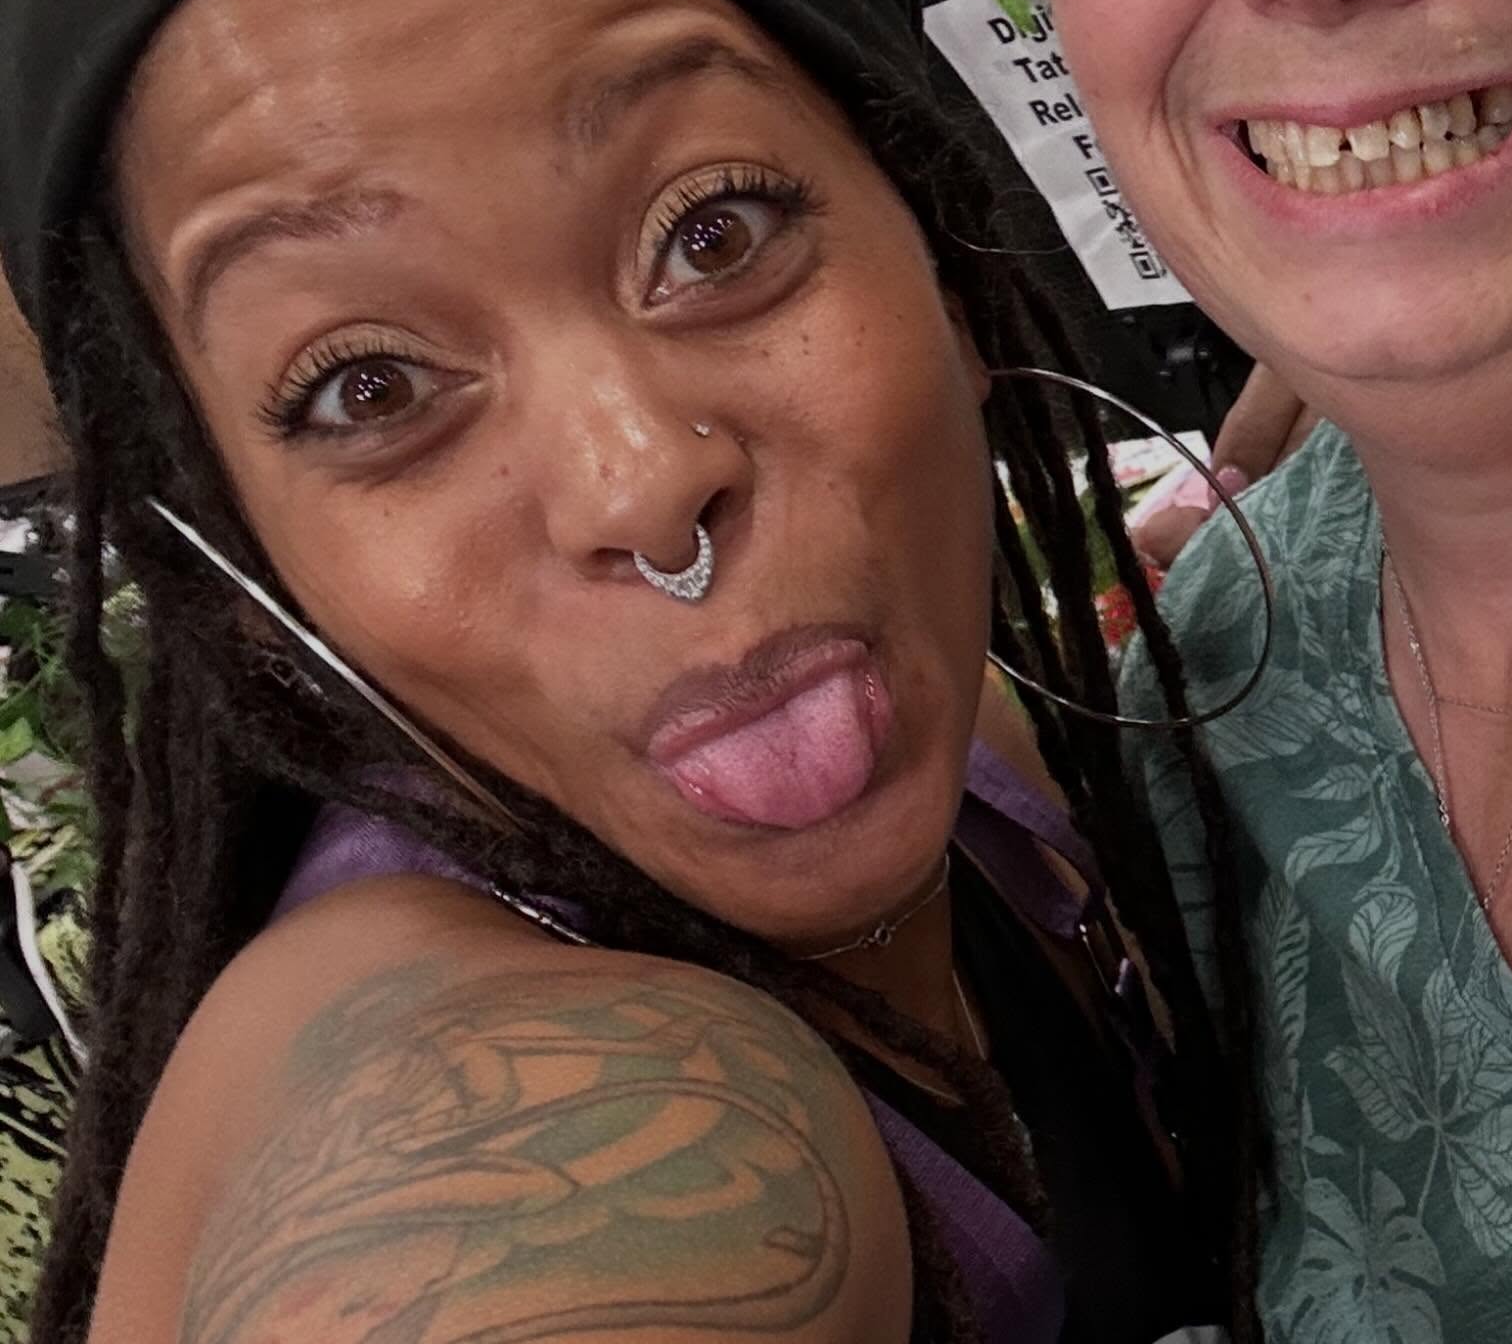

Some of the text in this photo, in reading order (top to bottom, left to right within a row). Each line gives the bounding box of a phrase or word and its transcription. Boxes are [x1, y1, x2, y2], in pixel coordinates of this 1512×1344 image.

[1011, 50, 1070, 84] Tat
[1027, 92, 1085, 127] Rel
[1071, 134, 1095, 160] F
